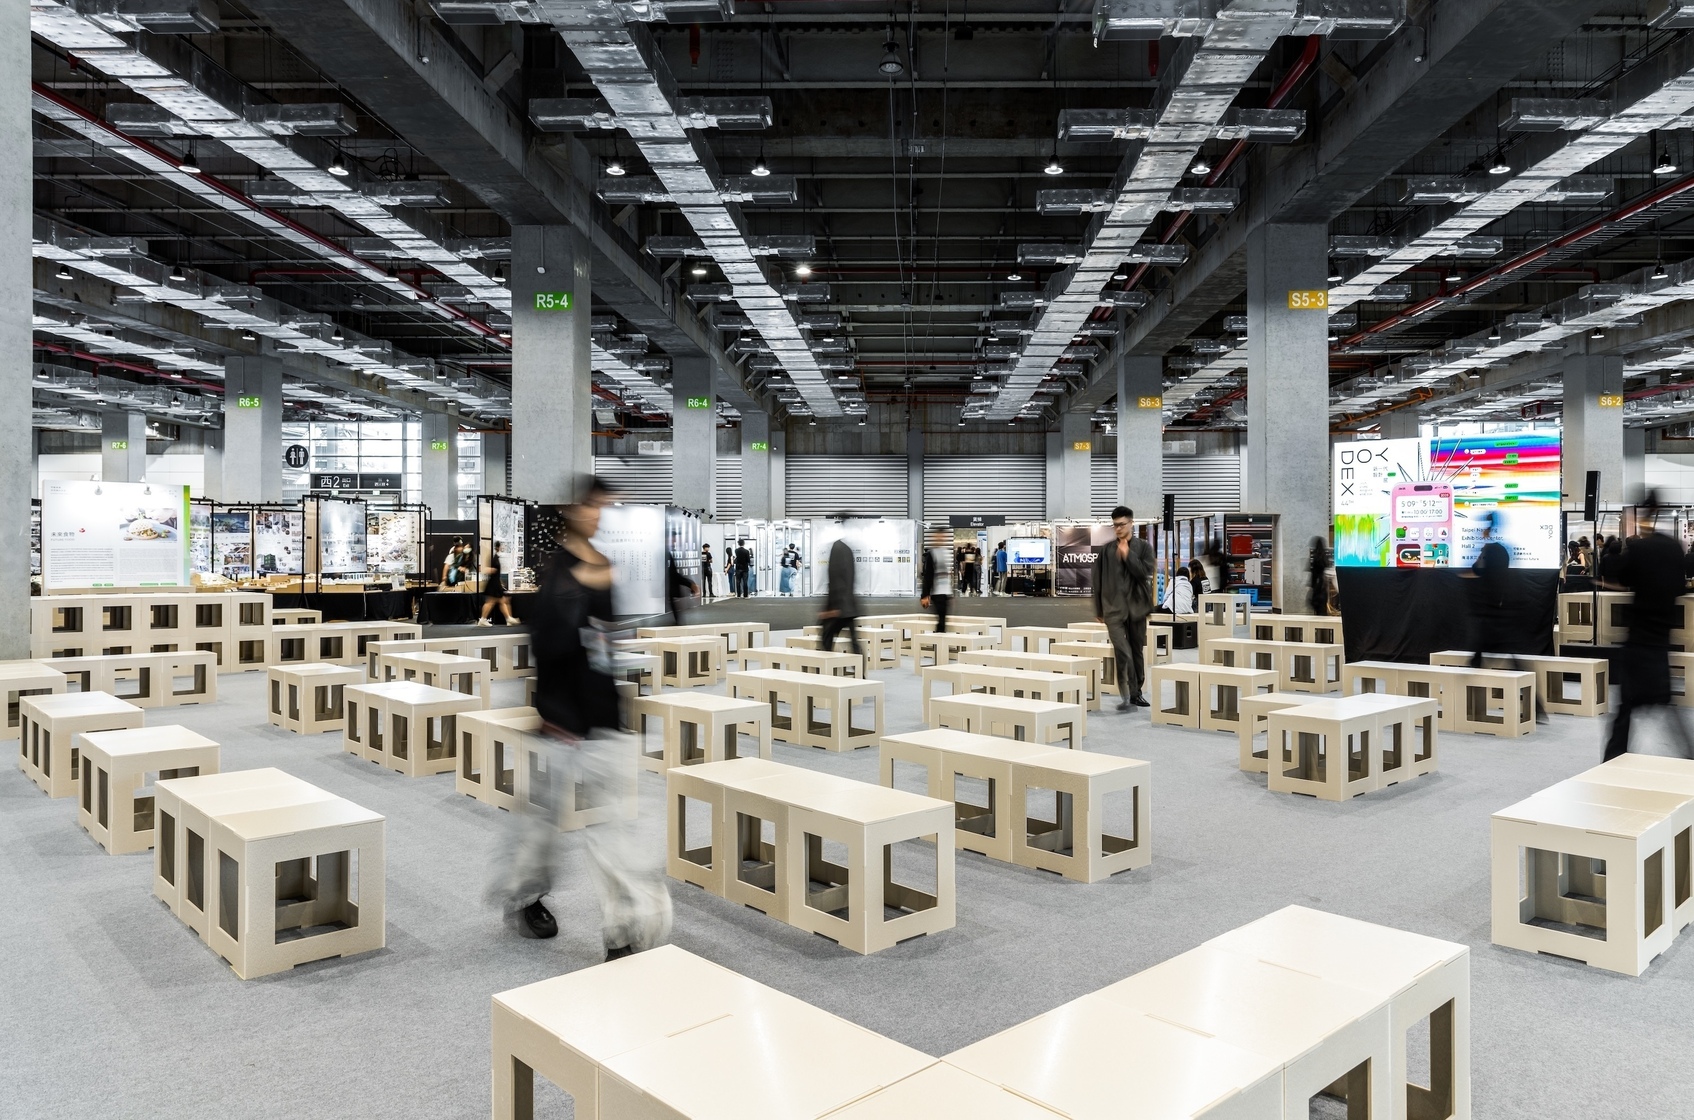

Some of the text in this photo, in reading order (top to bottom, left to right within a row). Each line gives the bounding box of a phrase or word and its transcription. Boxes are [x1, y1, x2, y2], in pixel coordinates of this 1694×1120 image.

[536, 294, 569, 308] R5-4
[1291, 292, 1325, 307] S5-3
[239, 398, 259, 407] R6-5
[688, 398, 708, 408] R6-4
[1140, 398, 1160, 407] S6-3
[1601, 397, 1621, 406] S6-2
[431, 442, 447, 450] R7-5
[1062, 553, 1099, 563] ATMOSP
